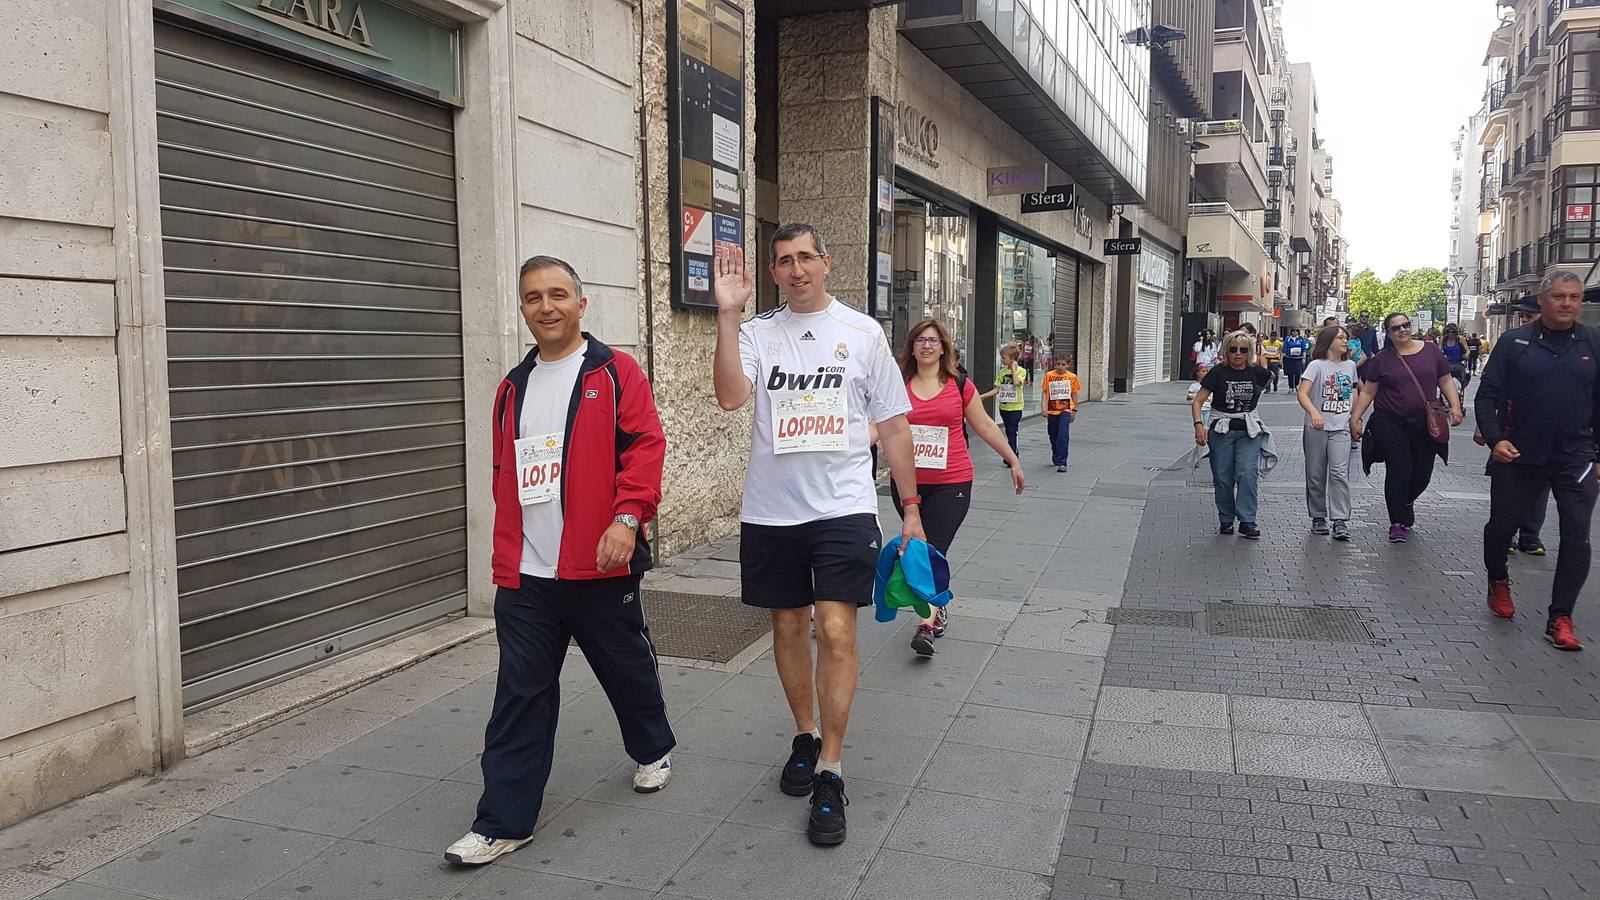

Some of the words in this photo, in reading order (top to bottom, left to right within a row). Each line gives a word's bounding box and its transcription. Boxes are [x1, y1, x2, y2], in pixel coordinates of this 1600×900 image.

[766, 365, 843, 391] bwin
[1322, 400, 1350, 414] BOSS
[778, 415, 845, 438] LOSPRA2
[913, 443, 945, 458] SPRA2
[522, 463, 547, 488] LOS
